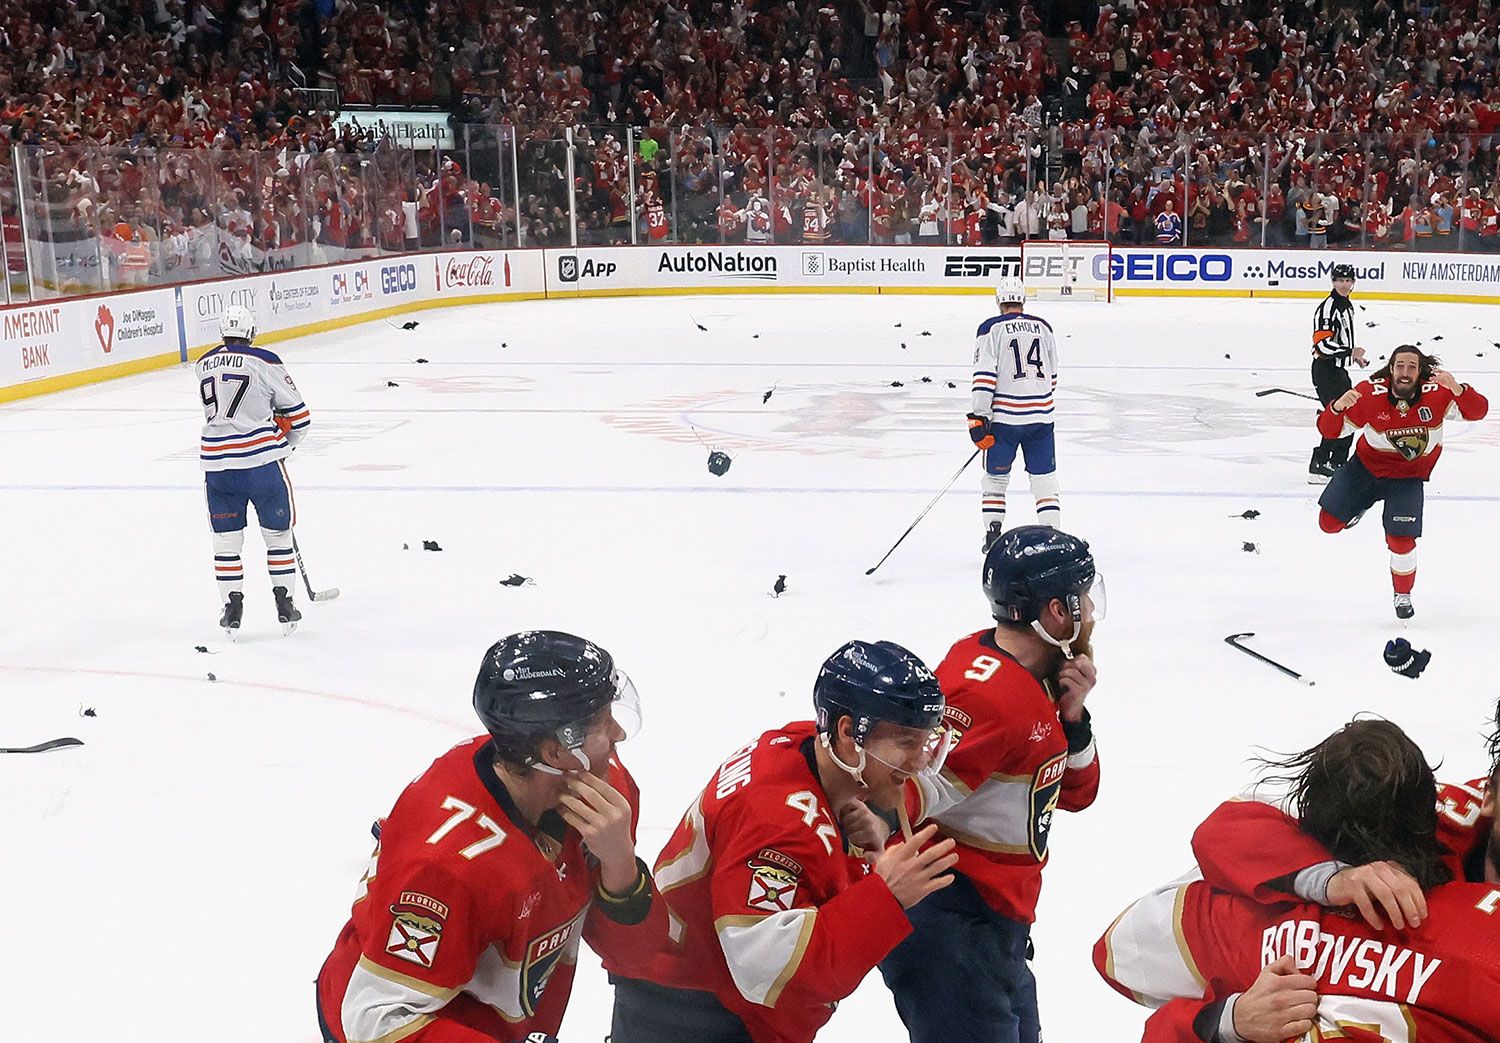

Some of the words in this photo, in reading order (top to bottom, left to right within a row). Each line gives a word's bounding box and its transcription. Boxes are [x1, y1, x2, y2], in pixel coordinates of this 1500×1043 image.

[658, 251, 777, 272] AutoNation
[828, 258, 876, 275] Baptist
[880, 257, 925, 272] Health
[944, 256, 1022, 277] ESPN
[1025, 256, 1085, 278] BET
[1092, 253, 1233, 282] GEICO
[1268, 259, 1385, 281] MassMual
[1402, 261, 1428, 280] NEW
[1430, 262, 1500, 283] AMSTERDAM
[381, 263, 416, 294] GEICO
[197, 293, 224, 317] CITY
[3, 309, 60, 340] AMERANT
[122, 311, 131, 324] Joe
[132, 309, 156, 323] DiMaggio
[117, 325, 143, 341] Children's
[143, 322, 164, 337] Hospital
[1005, 322, 1041, 334] EKHOLM
[22, 343, 50, 370] BANK
[203, 356, 243, 372] McDAVID
[1008, 338, 1045, 380] 14
[200, 373, 251, 423] 97
[964, 655, 1001, 681] 9
[425, 795, 508, 860] 77
[764, 850, 798, 870] FLORIDA
[406, 894, 444, 914] FLORIDA
